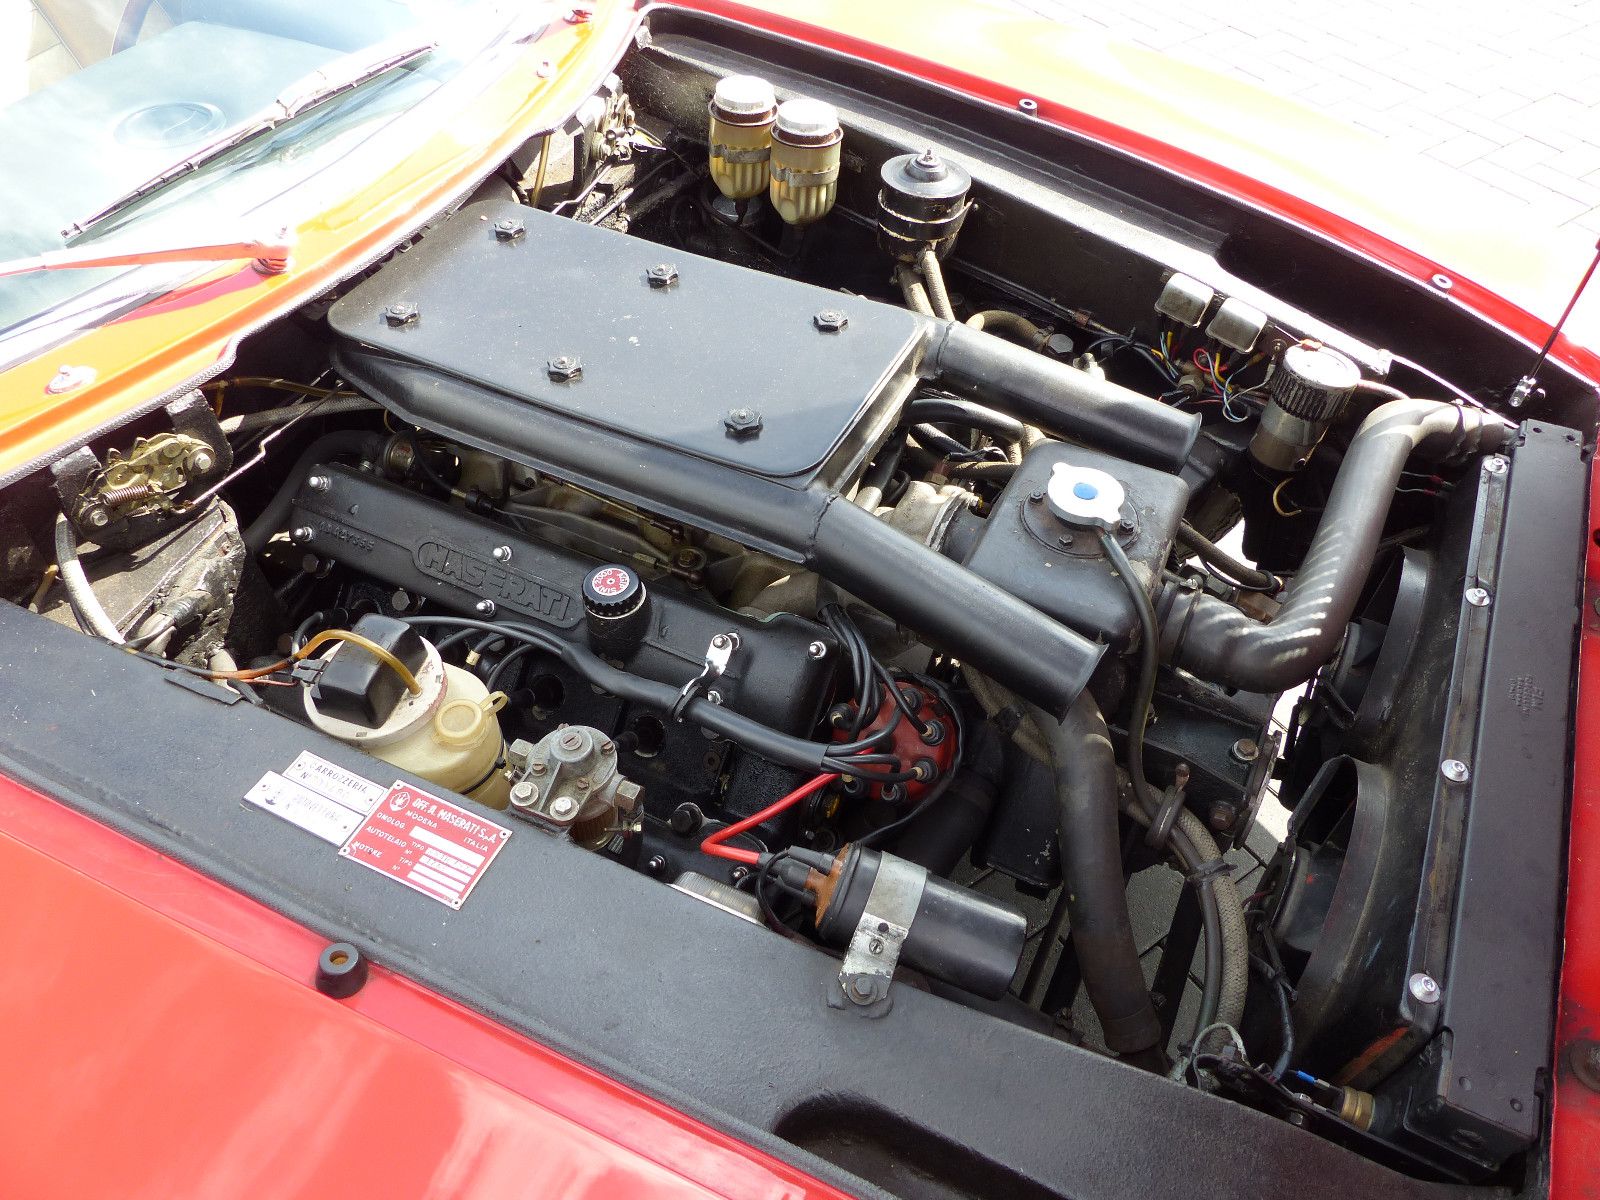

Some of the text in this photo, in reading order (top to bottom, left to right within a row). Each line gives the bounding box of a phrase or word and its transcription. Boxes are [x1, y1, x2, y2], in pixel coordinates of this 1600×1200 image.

[417, 541, 571, 621] MASERATI
[593, 569, 613, 587] 2000
[405, 810, 488, 852] MODENA ITALIA
[437, 809, 480, 836] MASERATI
[366, 826, 425, 850] AUTOTELAIO TIPO
[354, 841, 382, 858] MOTORE
[399, 856, 413, 866] TIPO
